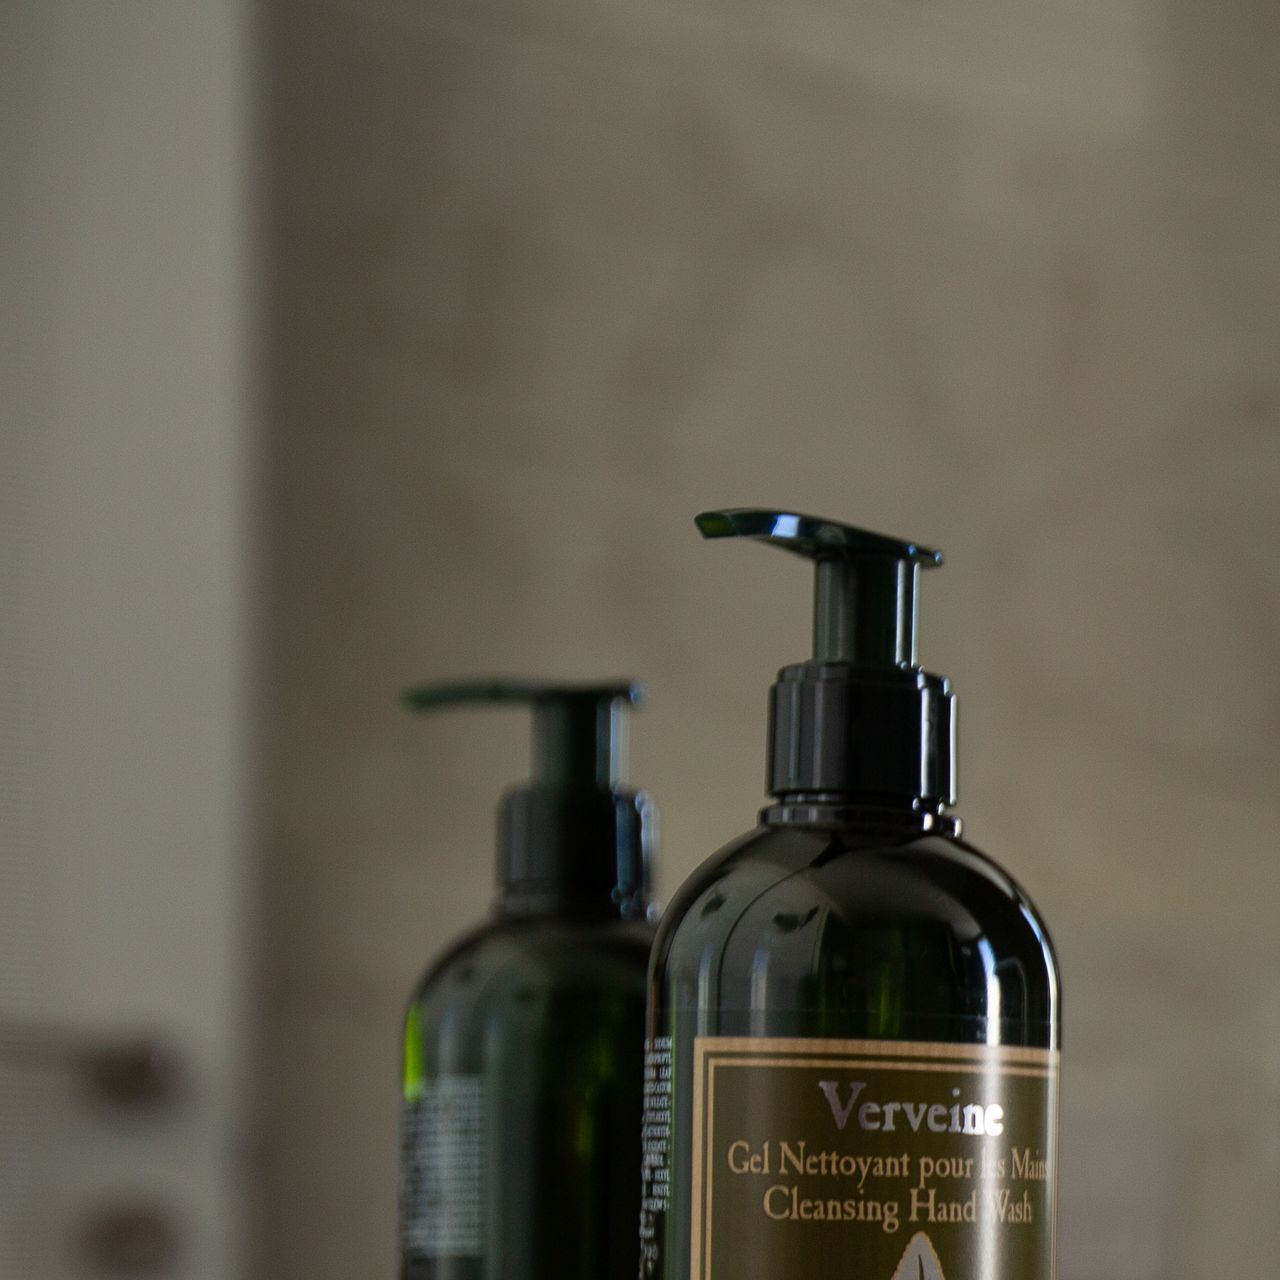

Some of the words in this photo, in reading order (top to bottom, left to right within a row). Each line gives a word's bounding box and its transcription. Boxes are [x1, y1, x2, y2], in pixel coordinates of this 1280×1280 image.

[819, 1080, 1004, 1137] Verveine
[727, 1140, 770, 1175] Gel
[779, 1140, 910, 1190] Nettoyant
[919, 1155, 974, 1190] pour
[763, 1184, 900, 1234] Cleansing
[909, 1187, 977, 1224] Hand
[990, 1188, 1032, 1225] Wash
